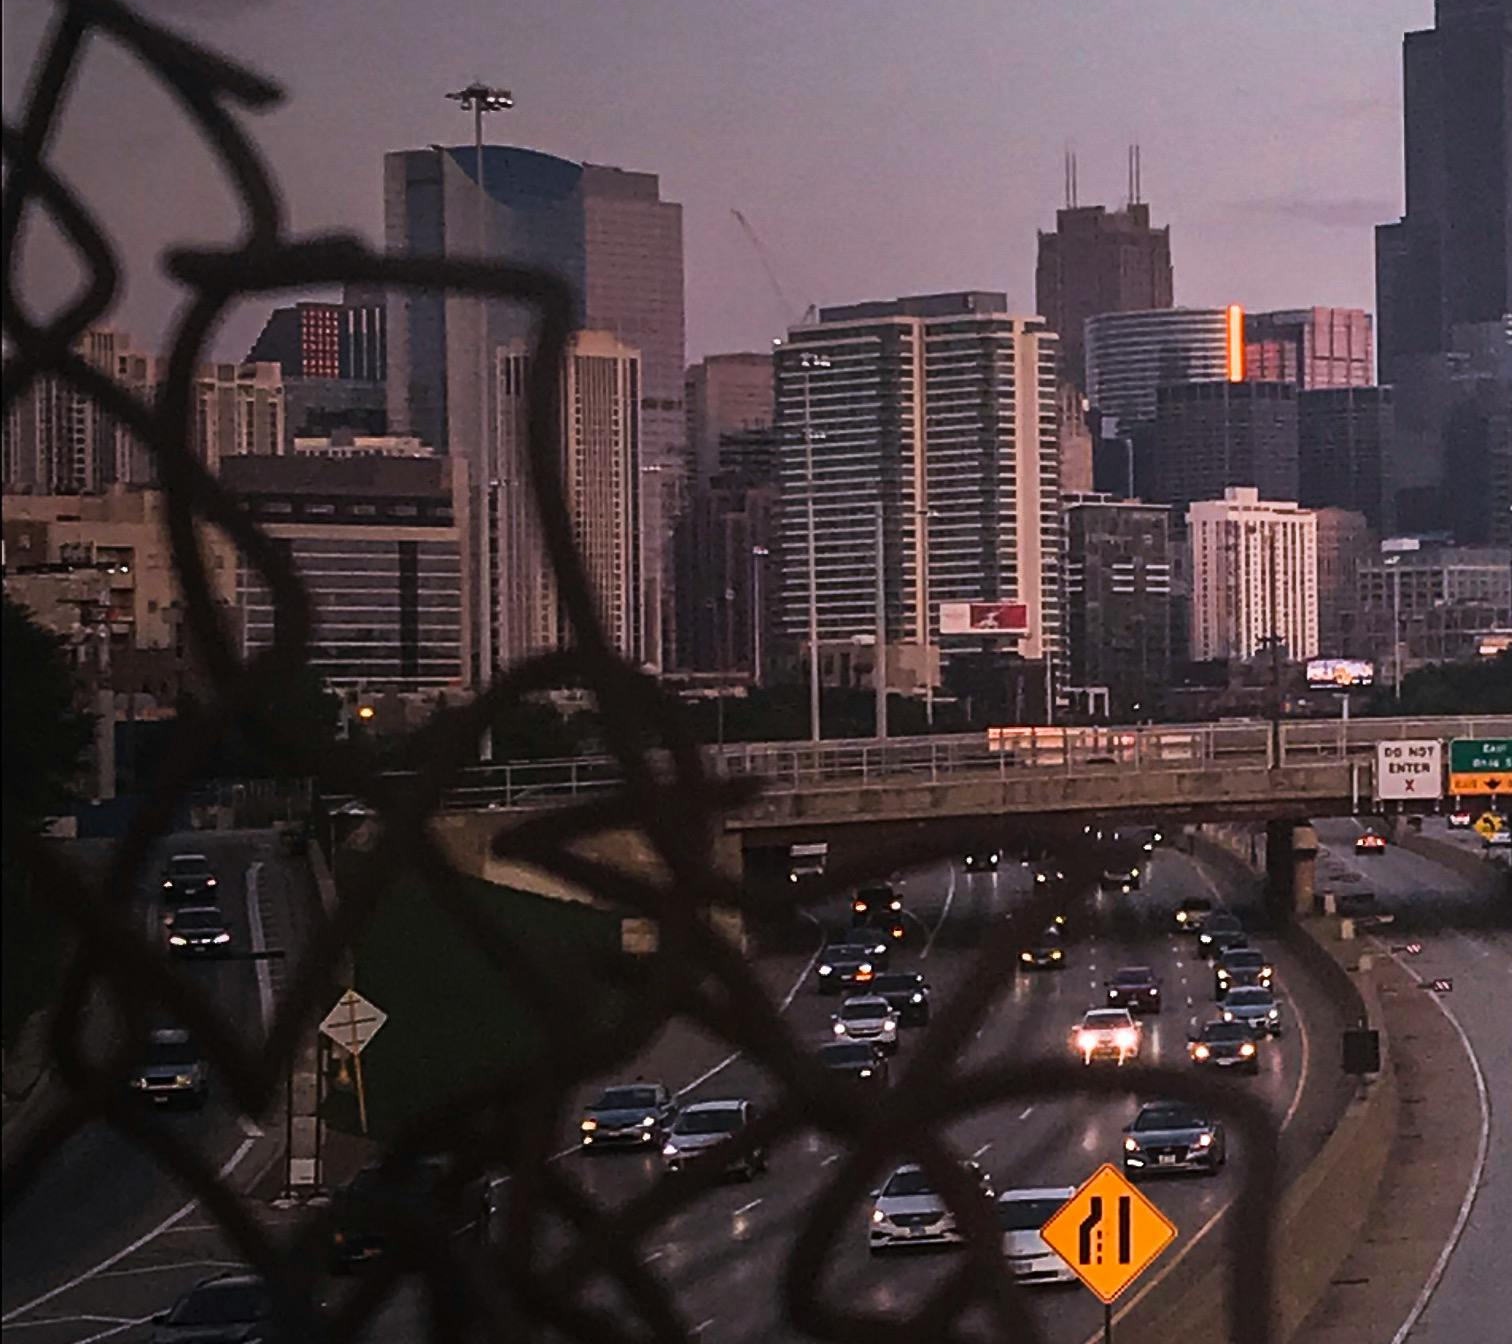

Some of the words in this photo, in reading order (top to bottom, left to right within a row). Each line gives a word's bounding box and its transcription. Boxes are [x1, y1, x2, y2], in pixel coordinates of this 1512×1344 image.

[1384, 747, 1402, 758] DO
[1408, 746, 1434, 757] NOT
[1389, 762, 1430, 774] ENTER
